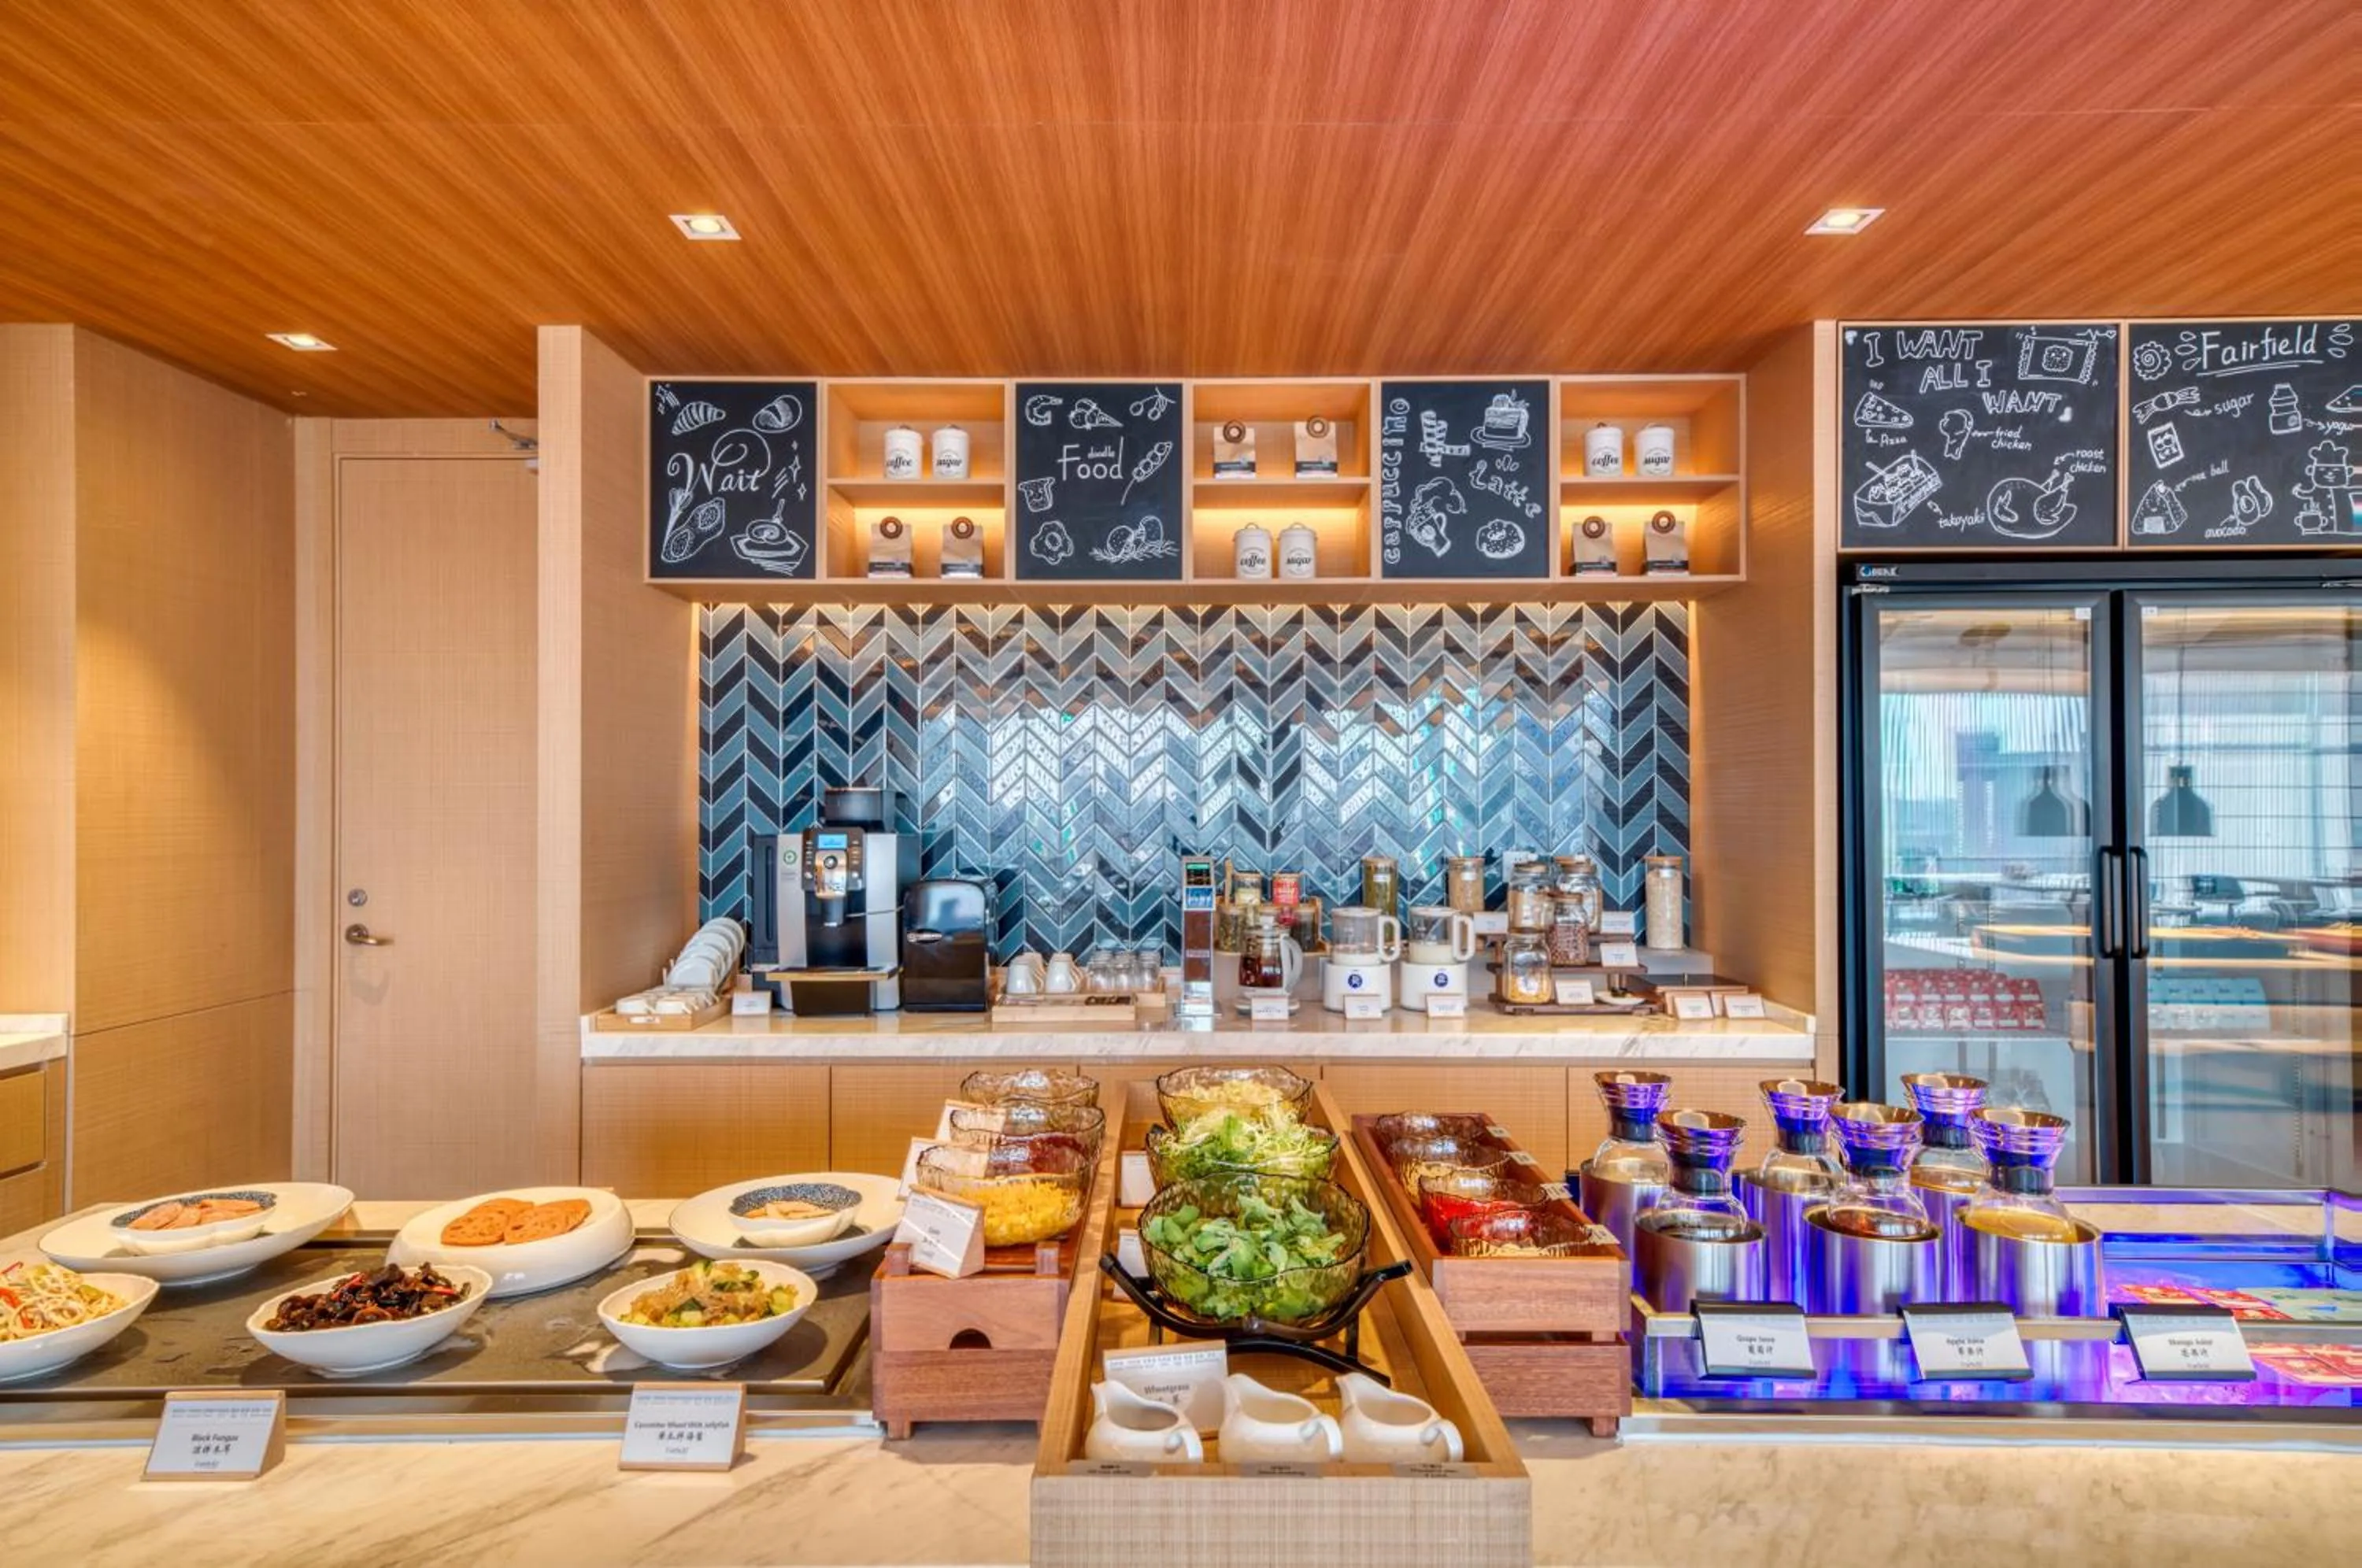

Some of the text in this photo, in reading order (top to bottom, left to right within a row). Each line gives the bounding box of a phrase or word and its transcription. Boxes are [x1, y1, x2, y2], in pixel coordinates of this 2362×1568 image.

[1864, 330, 1983, 368] I WANT
[2201, 323, 2318, 369] Fairfield
[1919, 360, 1993, 394] ALL I
[1982, 390, 2063, 415] WANT
[2214, 394, 2255, 418] sugar
[1995, 425, 2023, 438] fried
[1991, 438, 2032, 451] chicken
[2075, 448, 2105, 460] roast
[668, 428, 770, 495] Wait
[1057, 435, 1124, 481] Food
[2070, 461, 2106, 474] chicken
[1468, 460, 1542, 518] Latte
[191, 1433, 210, 1442] Black
